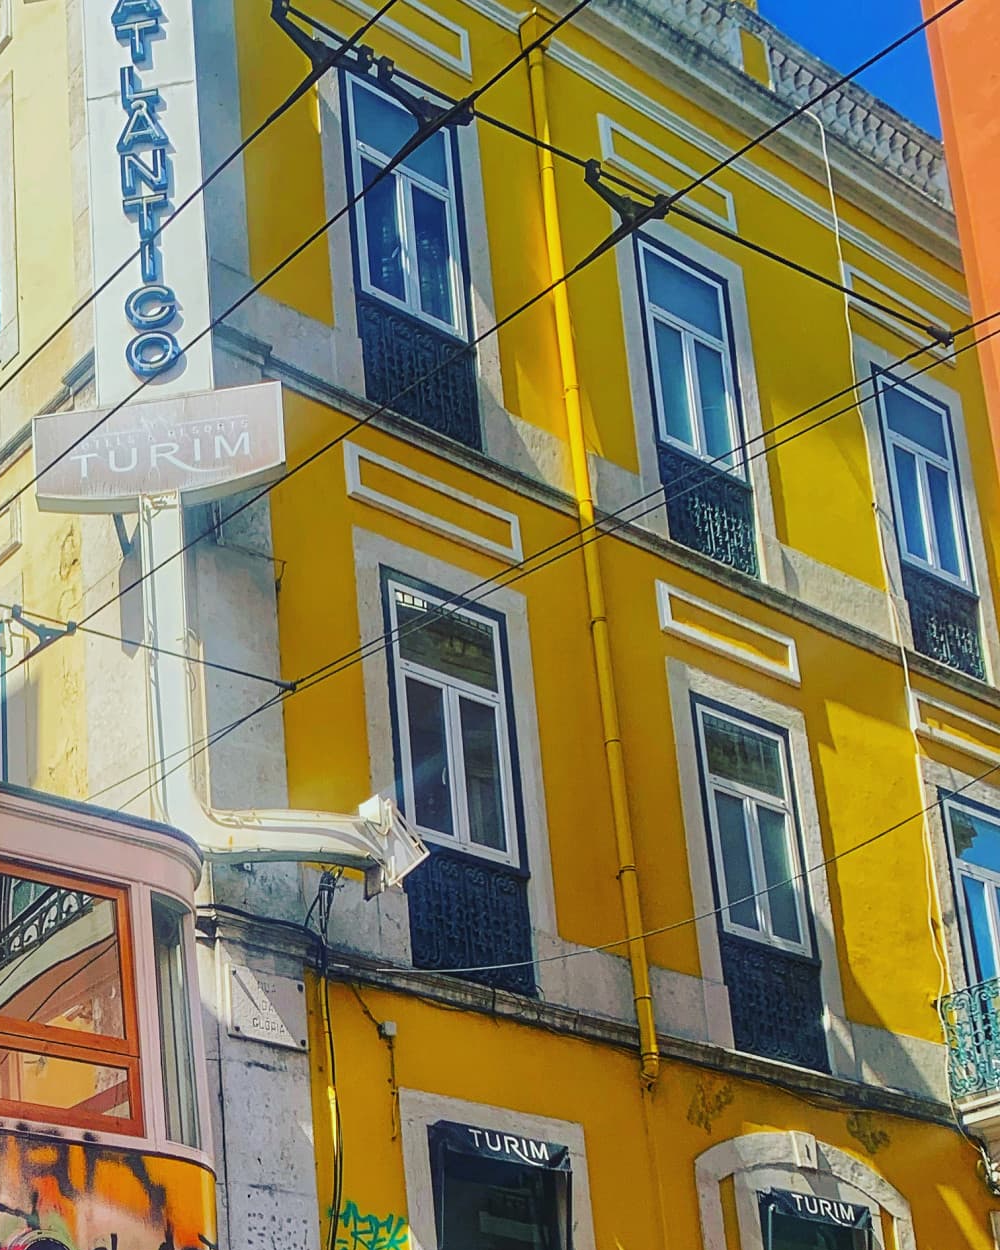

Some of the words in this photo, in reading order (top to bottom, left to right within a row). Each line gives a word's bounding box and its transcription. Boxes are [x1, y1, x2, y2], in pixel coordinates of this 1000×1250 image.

[70, 431, 253, 481] TURIM
[468, 1128, 550, 1167] TURIM
[790, 1193, 856, 1227] TURIM
